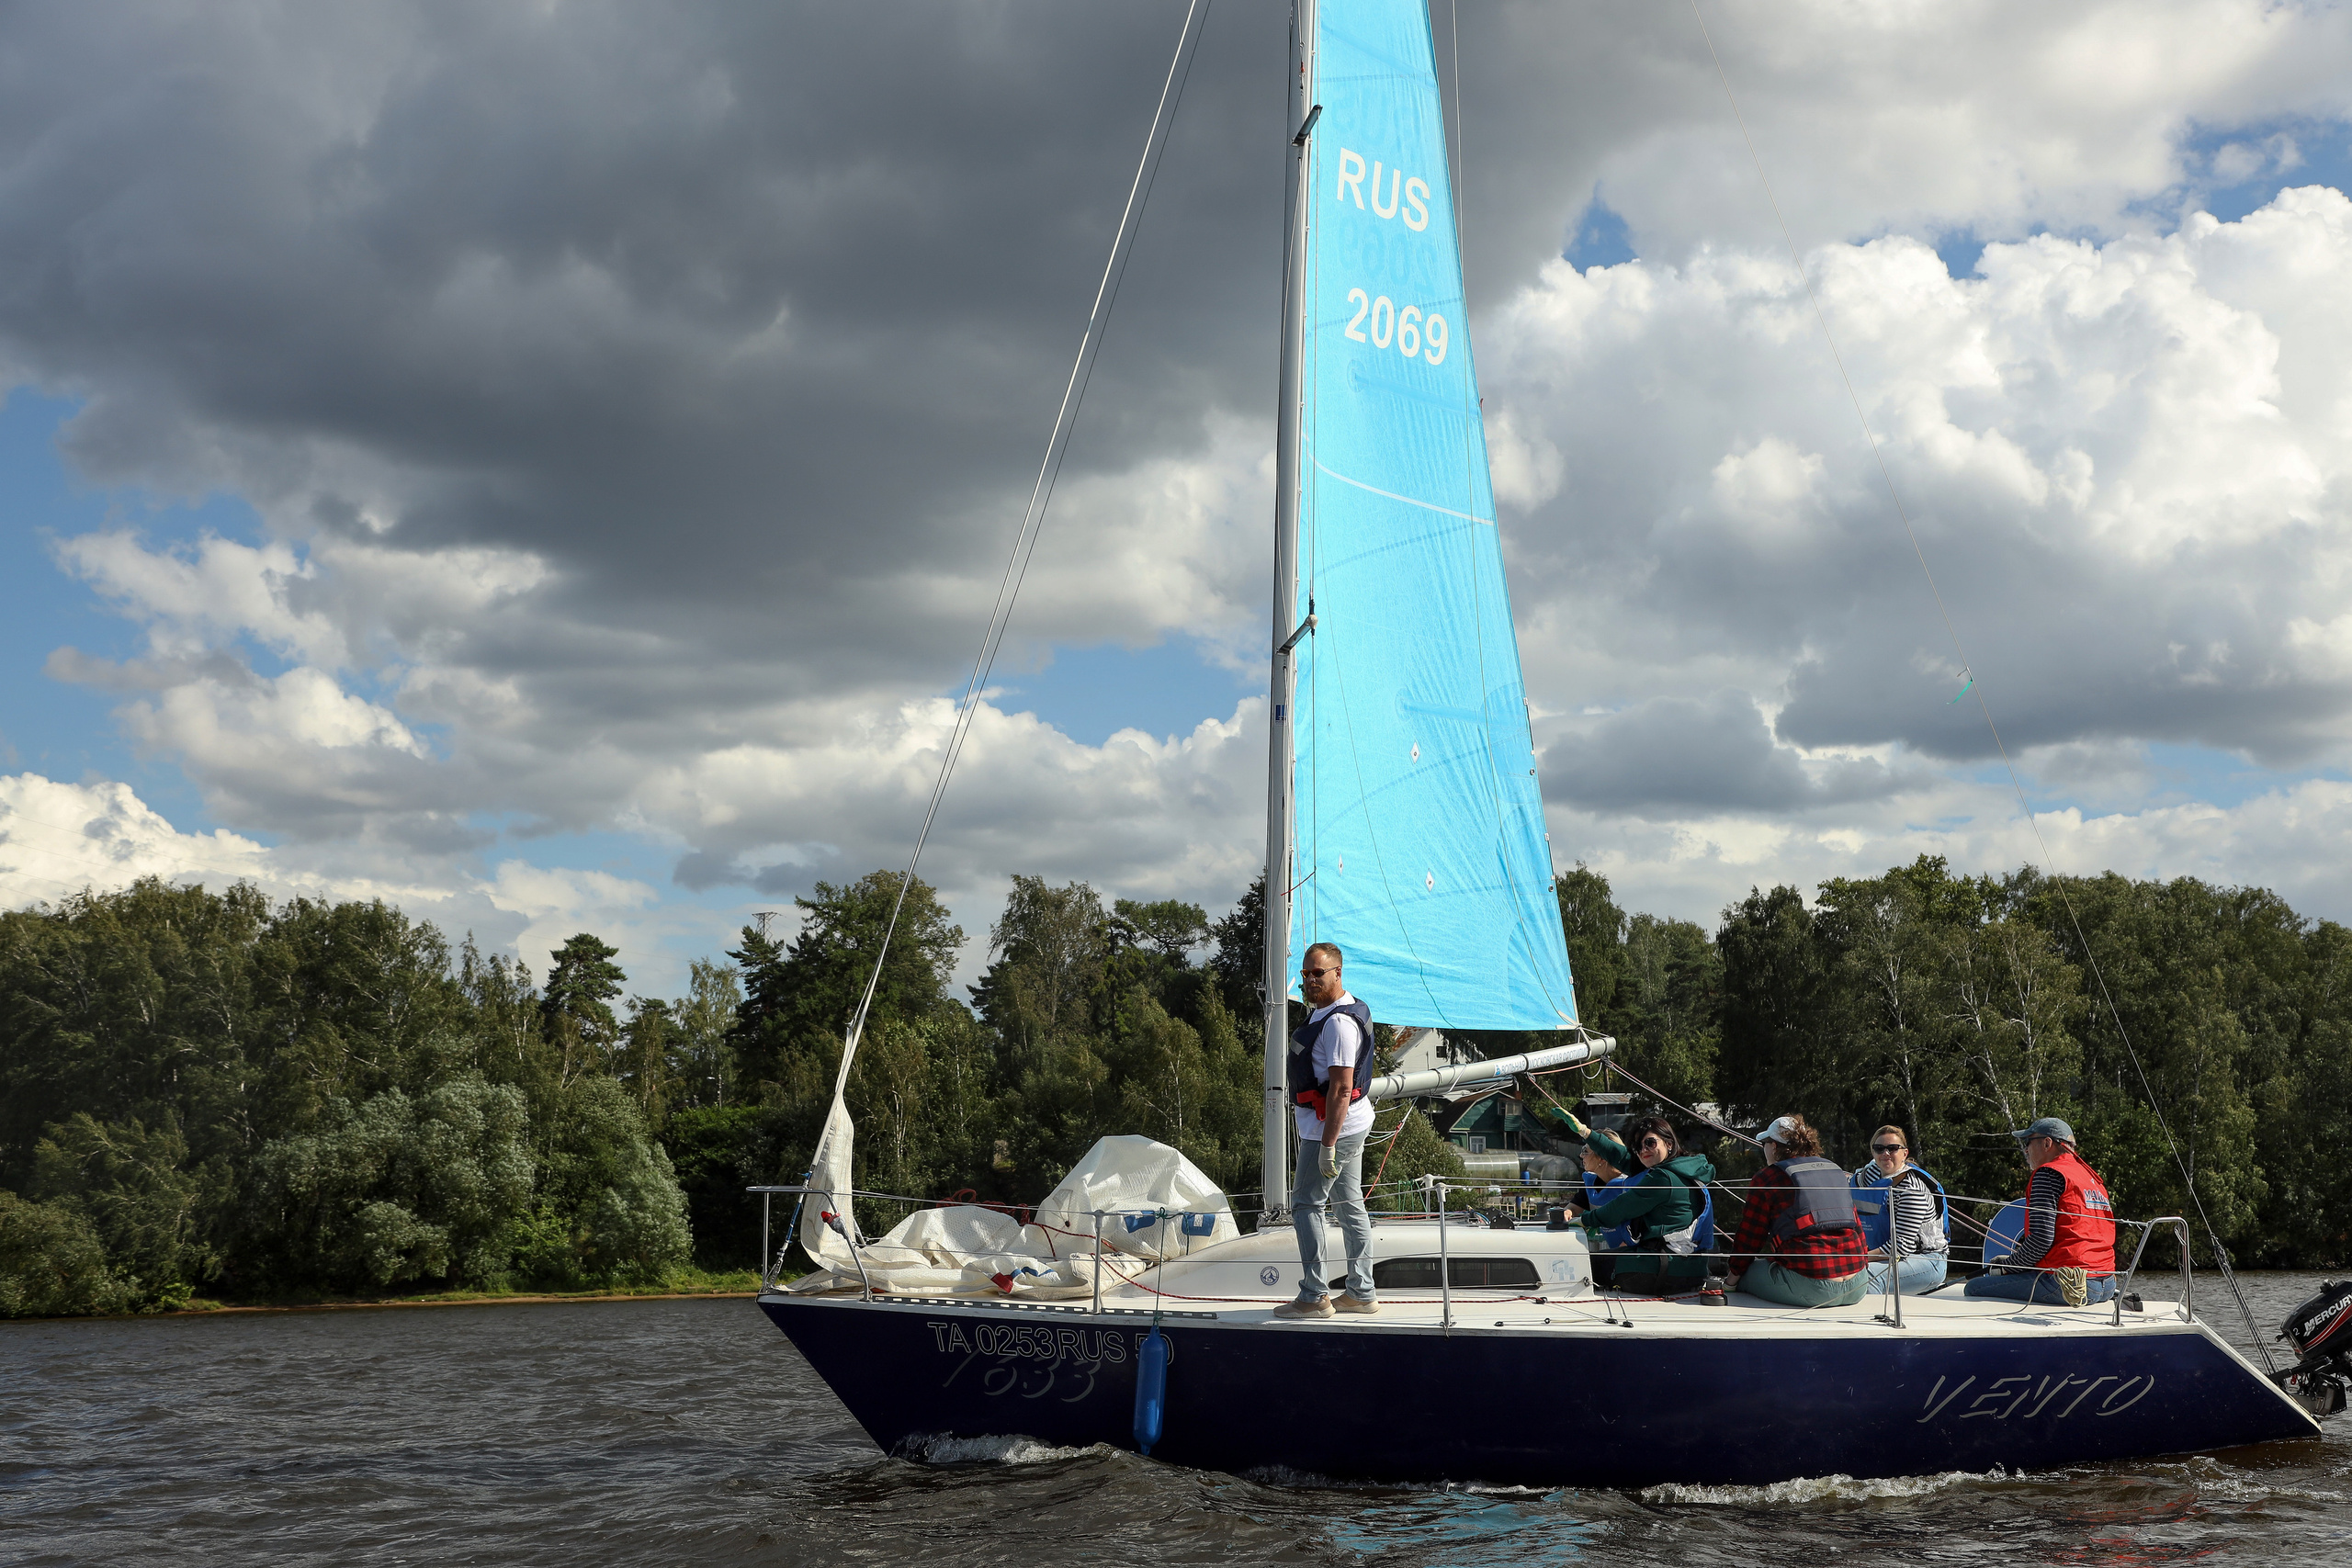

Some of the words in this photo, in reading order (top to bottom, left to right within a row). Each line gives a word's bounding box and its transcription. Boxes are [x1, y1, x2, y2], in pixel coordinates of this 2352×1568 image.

[1337, 147, 1430, 232] RUS
[1344, 288, 1449, 366] 2069
[927, 1322, 972, 1354] TA
[1917, 1373, 2154, 1423] VENTO
